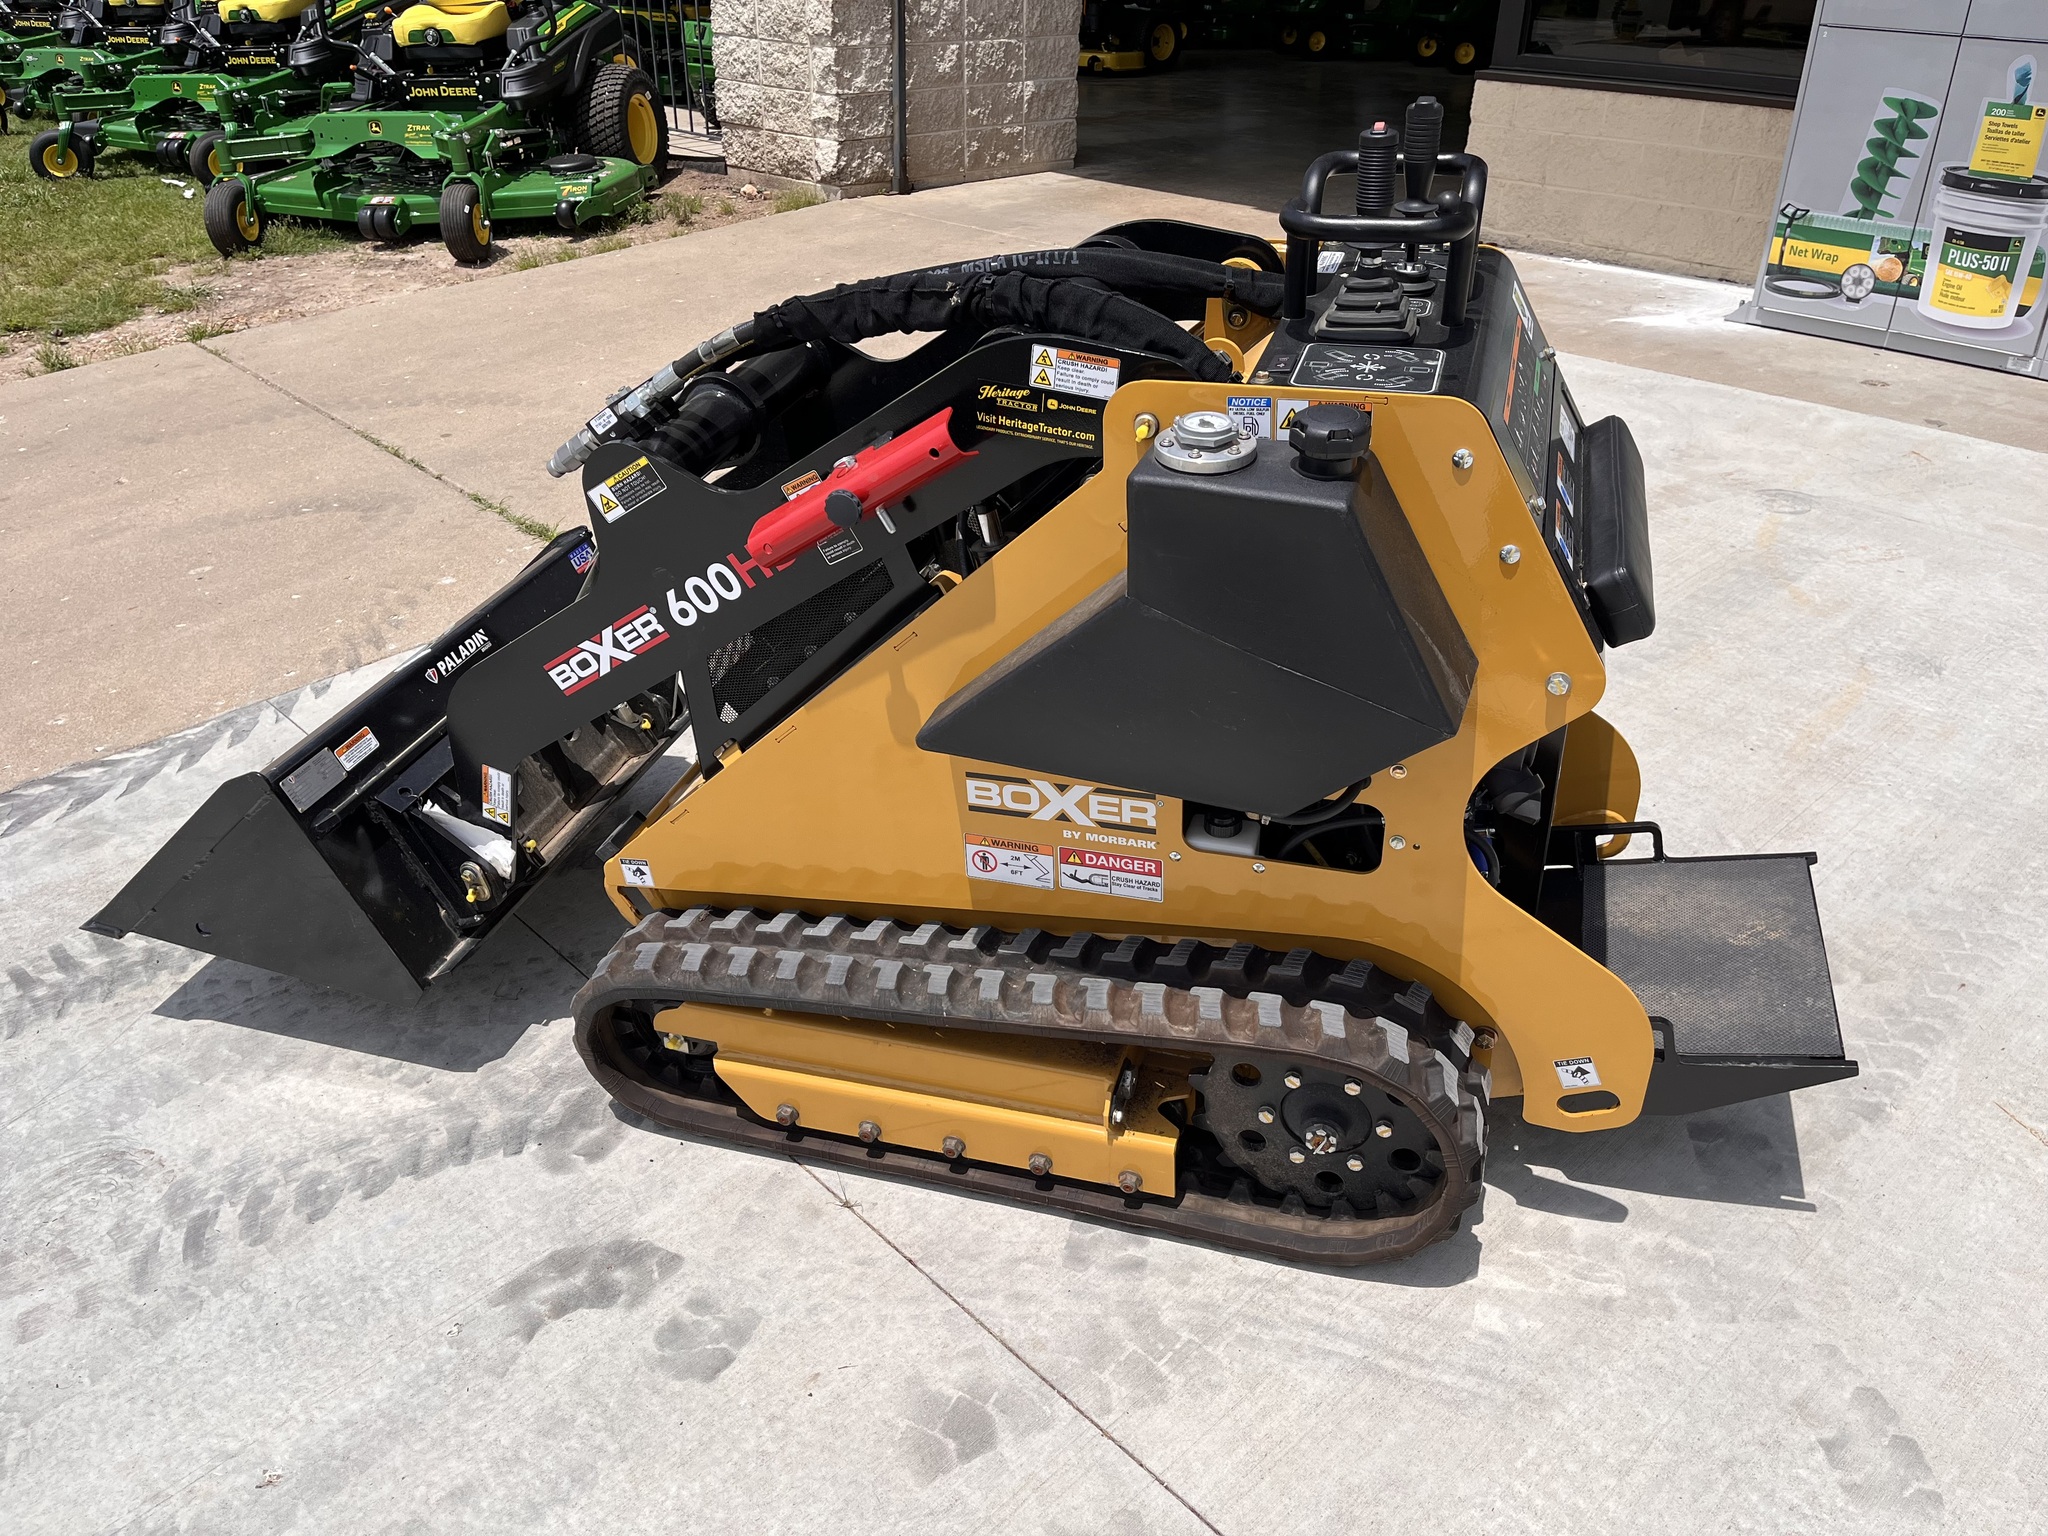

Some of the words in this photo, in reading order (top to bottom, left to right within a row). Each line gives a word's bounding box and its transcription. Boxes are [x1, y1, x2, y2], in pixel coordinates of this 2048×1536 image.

[14, 19, 30, 27] JOHN
[31, 20, 51, 28] DEERE
[107, 35, 126, 44] JOHN
[126, 35, 150, 44] DEERE
[228, 56, 249, 65] JOHN
[249, 55, 277, 64] DEERE
[409, 86, 439, 97] JOHN
[439, 86, 478, 96] DEERE
[1991, 108, 2007, 117] 200
[407, 124, 431, 132] ZTRAK
[1988, 120, 2001, 128] Shop
[1984, 135, 2009, 143] Serviettes
[1788, 245, 1808, 258] Net
[1811, 248, 1839, 264] Wrap
[1947, 248, 2000, 272] PLUS-50
[2000, 256, 2011, 272] II
[1941, 281, 1955, 290] Engine
[1057, 359, 1080, 369] CRUSH
[1080, 363, 1108, 373] HAZARD!
[1076, 354, 1109, 365] WARNING
[1055, 383, 1074, 391] serious
[1081, 375, 1100, 383] comply
[1100, 378, 1115, 386] could
[977, 384, 1031, 399] Heritage
[996, 398, 1038, 412] TRACTOR
[1059, 403, 1076, 411] JOHN
[1076, 405, 1097, 415] DEERE
[1231, 398, 1268, 407] NOTICE
[1325, 402, 1366, 410] NING
[976, 411, 997, 424] Visit
[998, 414, 1095, 442] HeritageTractor.com
[617, 462, 641, 479] CAUTION
[790, 474, 818, 491] WARNING
[569, 546, 583, 559] MADE
[572, 551, 593, 568] USA
[436, 629, 489, 676] PALADIN
[548, 612, 666, 691] BOXER
[965, 779, 1157, 828] BOXER
[991, 839, 1039, 853] WARNING
[1062, 829, 1081, 840] BY
[1086, 832, 1157, 850] MORBARK
[1085, 853, 1156, 874] DANGER
[1111, 875, 1134, 885] CRUSH
[1135, 878, 1161, 888] HAZARD
[1111, 881, 1122, 889] Stay
